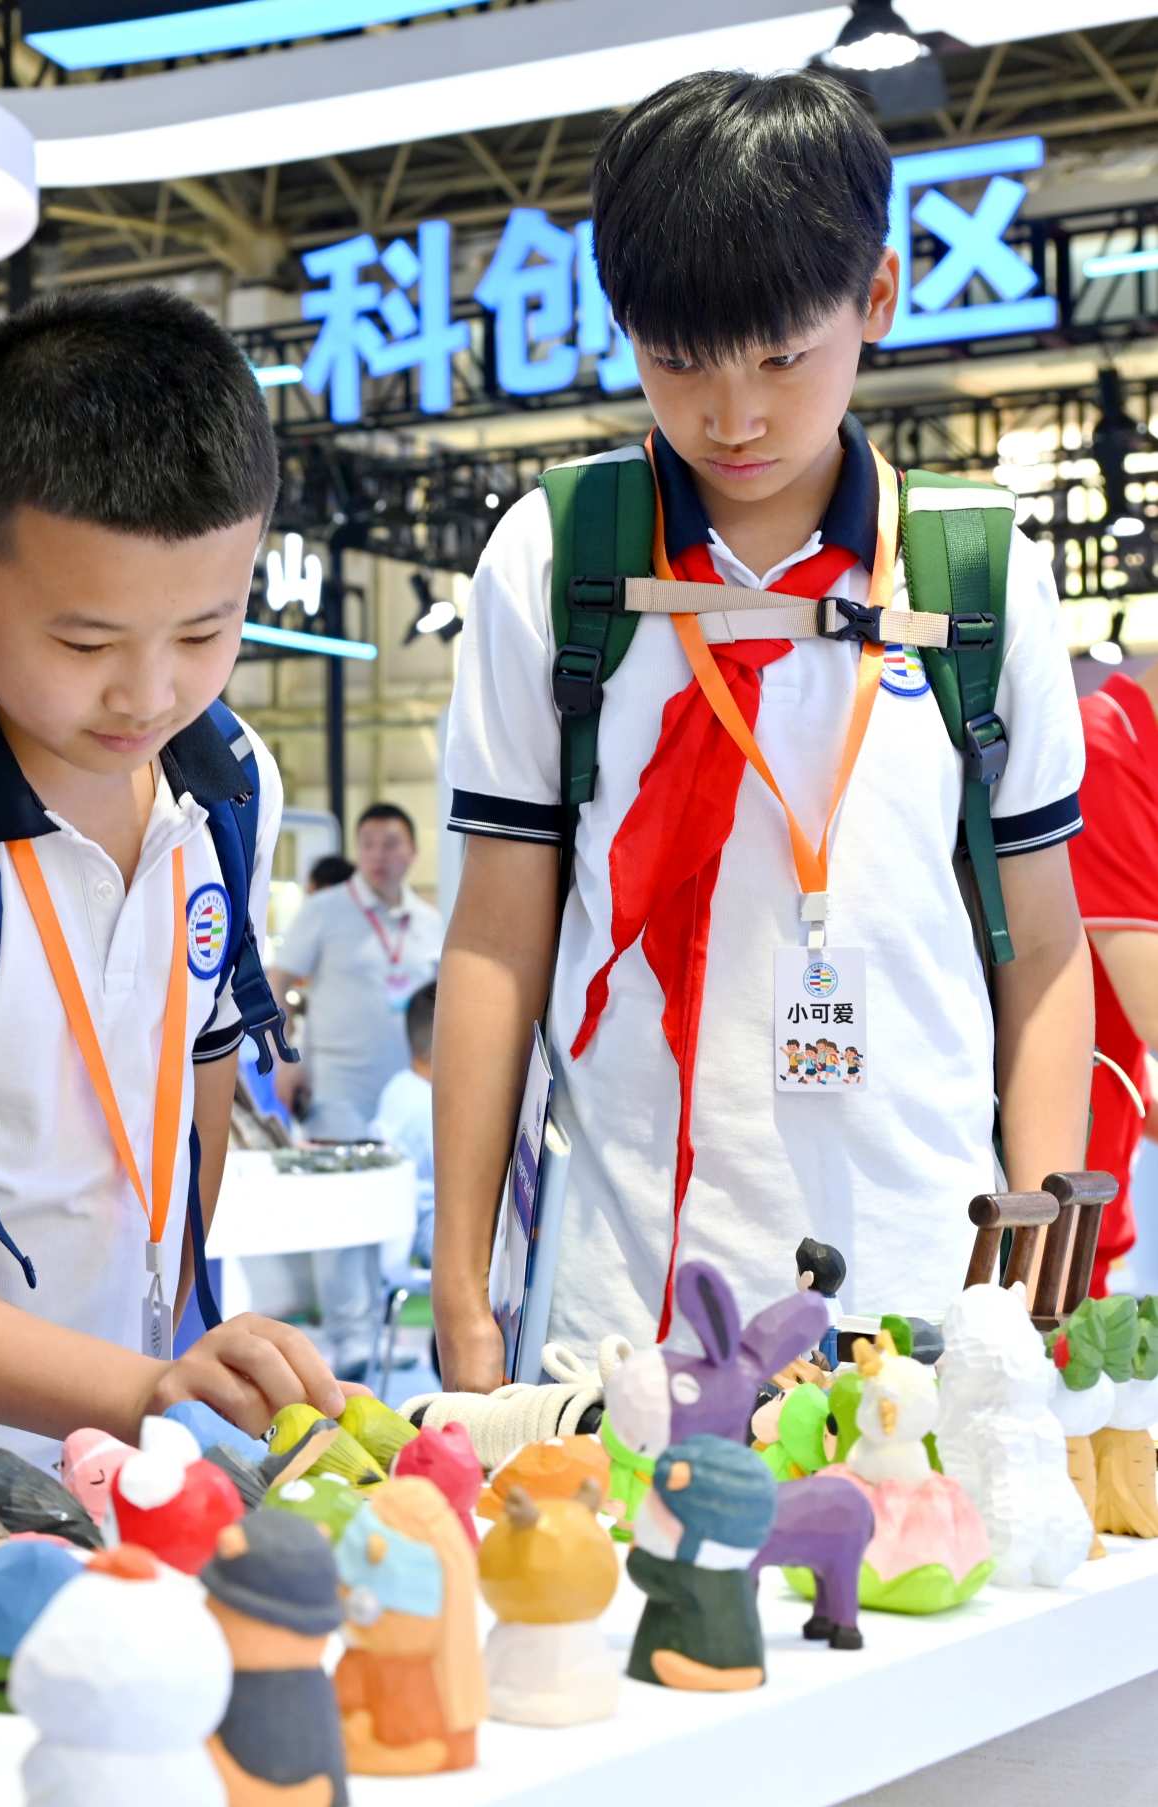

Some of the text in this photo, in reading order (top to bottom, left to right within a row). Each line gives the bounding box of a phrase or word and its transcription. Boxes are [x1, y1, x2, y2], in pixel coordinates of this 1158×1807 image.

[301, 132, 1059, 424] 科创区
[266, 532, 323, 616] 山
[787, 1002, 854, 1024] 小可爱
